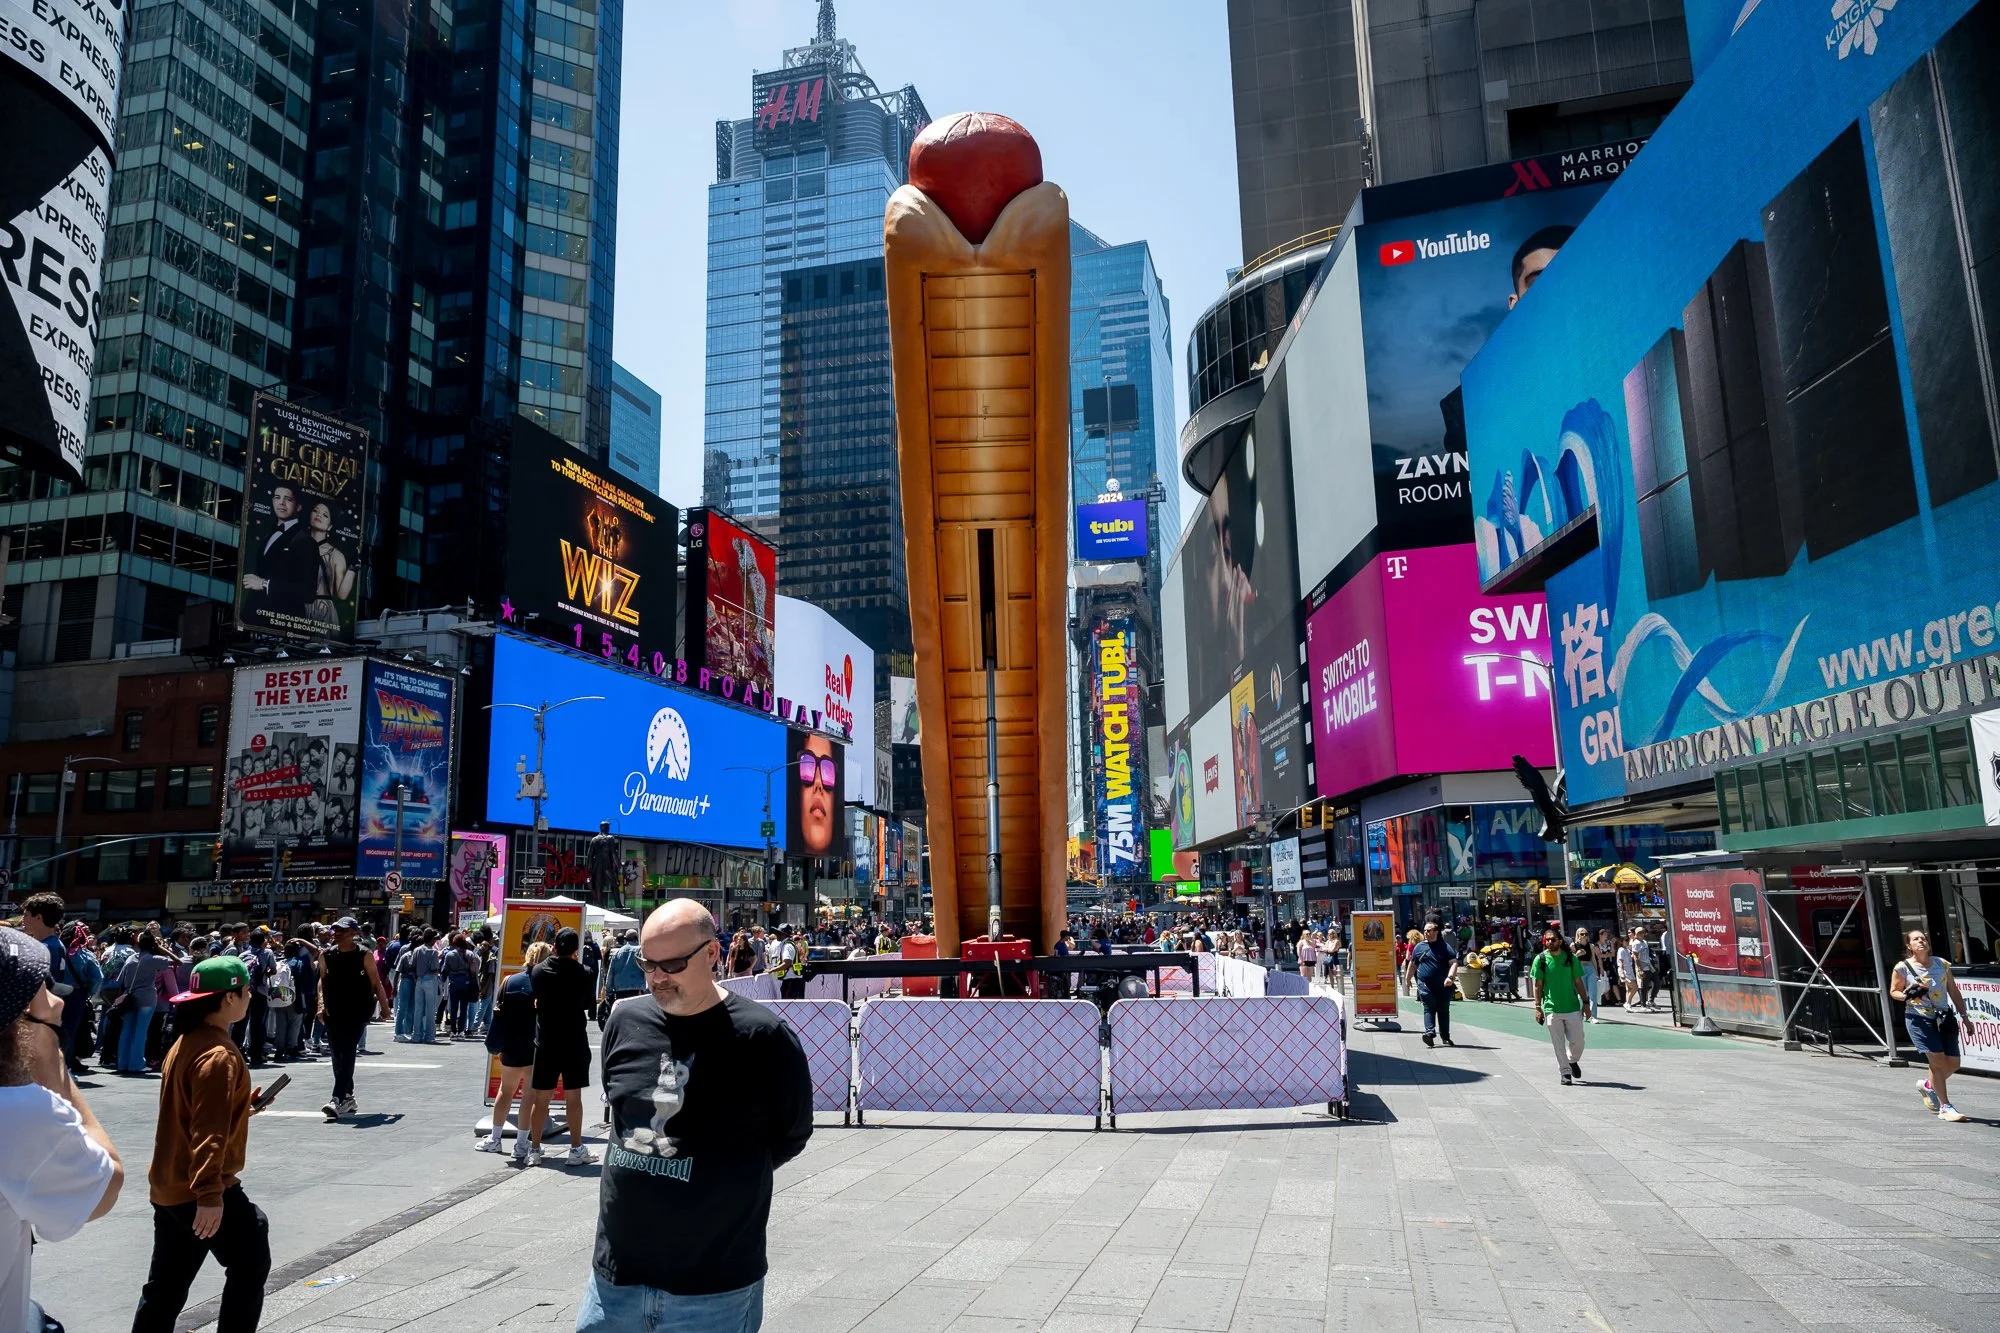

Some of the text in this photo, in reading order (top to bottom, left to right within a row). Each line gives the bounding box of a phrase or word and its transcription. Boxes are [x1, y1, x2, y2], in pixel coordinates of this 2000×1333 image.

[32, 0, 116, 90] EXPRESS
[1417, 230, 1490, 259] YouTube
[30, 313, 94, 382] EXPRESS
[302, 416, 352, 440] BEWITCHING
[299, 443, 358, 479] GREAT
[1395, 451, 1469, 480] ZAYN
[270, 457, 349, 496] GATSBY
[551, 459, 561, 472] TO
[561, 465, 576, 481] THIS
[576, 474, 618, 504] SPECTACULAR
[581, 466, 602, 485] DON'T
[602, 480, 617, 494] EASE
[627, 493, 644, 510] DOWN
[1097, 492, 1123, 504] 2024
[1398, 482, 1462, 505] ROOM
[1089, 519, 1134, 535] tubi
[599, 544, 613, 559] THE
[690, 540, 703, 548] LG
[559, 538, 641, 626] WIZ
[276, 612, 313, 625] BROADWAY
[313, 620, 341, 632] THEATRE
[293, 622, 328, 635] BROADWAY
[1322, 638, 1370, 694] SWITCH TO
[1561, 603, 1618, 709] 格
[265, 667, 342, 689] BEST OF
[374, 676, 448, 700] MUSICAL THEATER HISTORY
[409, 677, 417, 685] TO
[417, 678, 440, 691] CHANGE
[826, 664, 843, 697] Real
[255, 685, 348, 706] THE YEAR!
[676, 659, 823, 729] BROADWAY
[1323, 671, 1378, 734] T-MOBILE
[375, 688, 444, 726] BACK
[395, 721, 444, 742] FUTURE
[1624, 716, 1760, 783] AMERICAN
[1764, 686, 1879, 749] EAGLE
[1100, 631, 1134, 864] 75M WATCH TUBI.
[619, 771, 710, 819] Paramount+
[1335, 807, 1350, 818] SEPHORA
[665, 843, 726, 877] FOREVER
[1330, 868, 1356, 883] SEPHORA
[742, 889, 752, 897] POLO
[1686, 889, 1714, 899] todaytix
[1684, 908, 1721, 921] Broadway's
[1681, 921, 1697, 932] best
[1704, 923, 1711, 933] at
[1711, 924, 1727, 935] your
[1688, 934, 1721, 948] fingertips.
[1962, 983, 1972, 991] ITS
[1973, 983, 1990, 992] FIFTH
